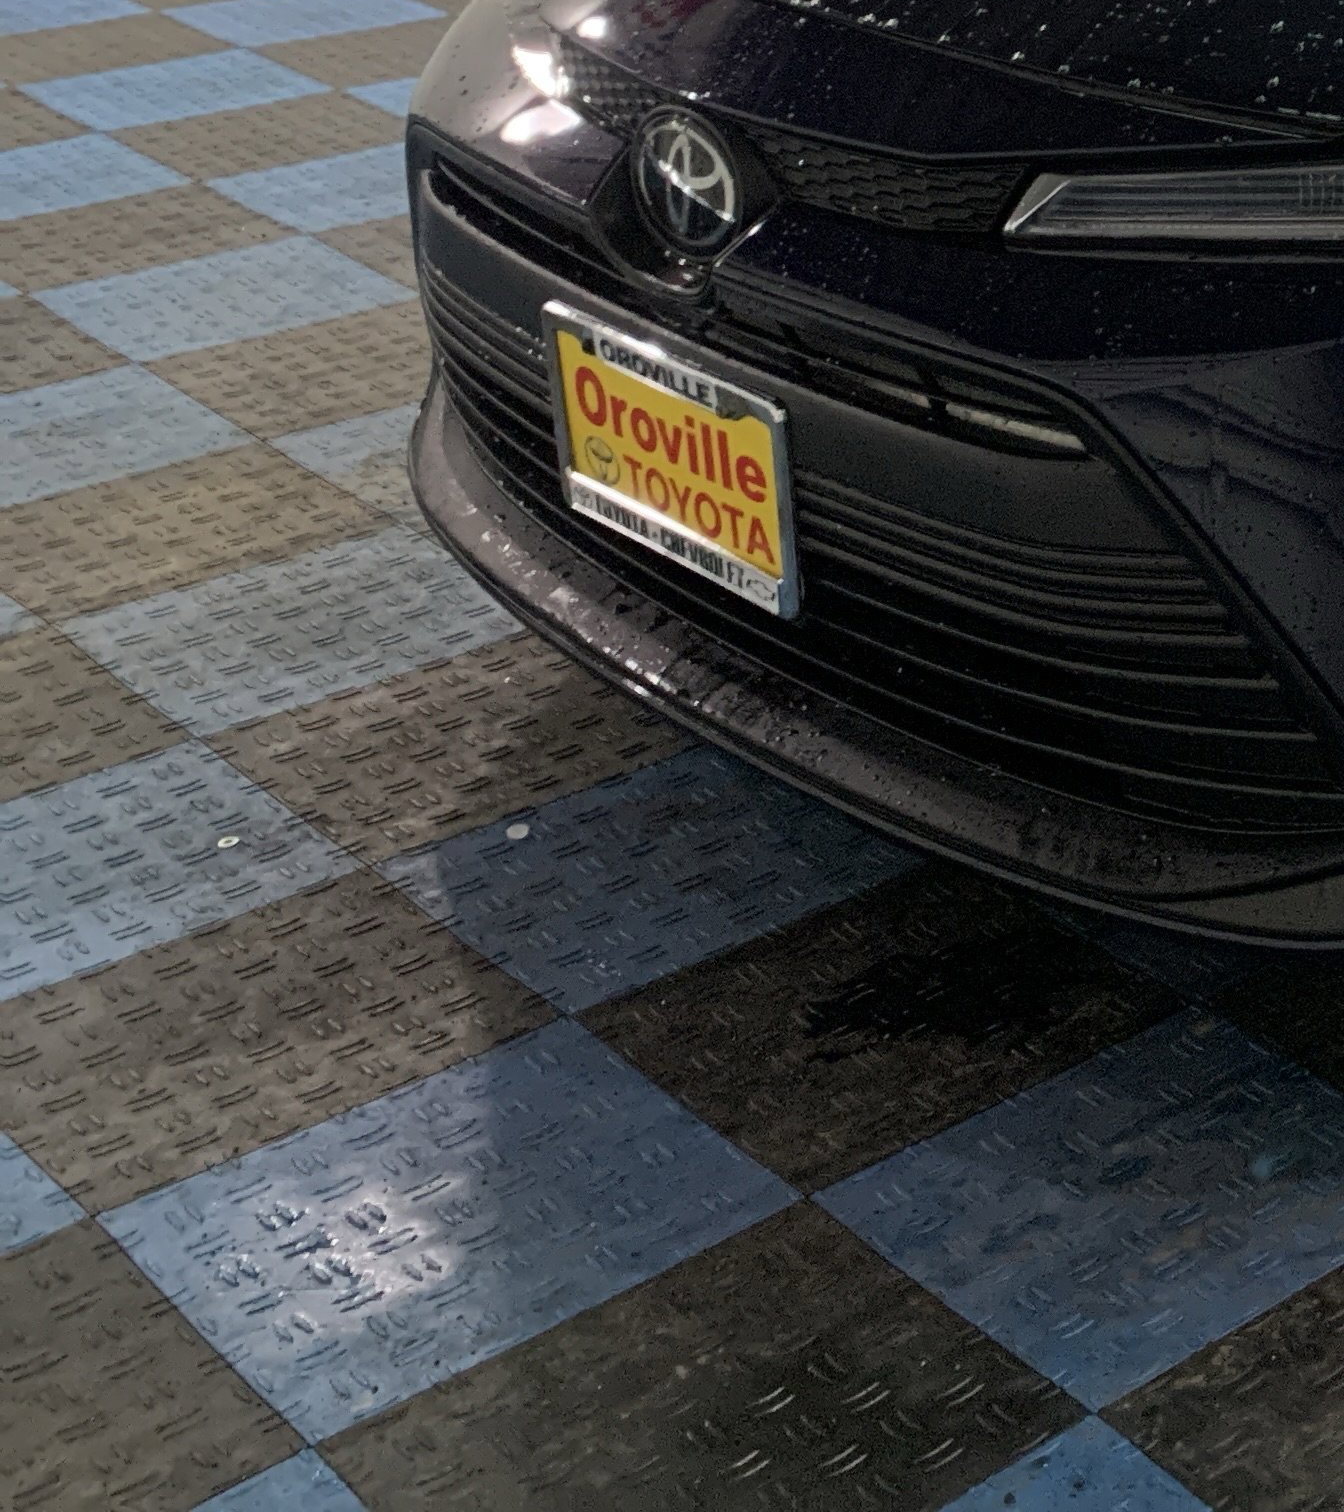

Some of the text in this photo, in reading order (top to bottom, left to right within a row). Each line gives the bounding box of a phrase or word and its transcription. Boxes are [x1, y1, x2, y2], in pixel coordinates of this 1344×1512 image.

[599, 337, 715, 407] OROVILLE
[575, 365, 767, 504] Oroville
[623, 453, 775, 565] TOYOTA
